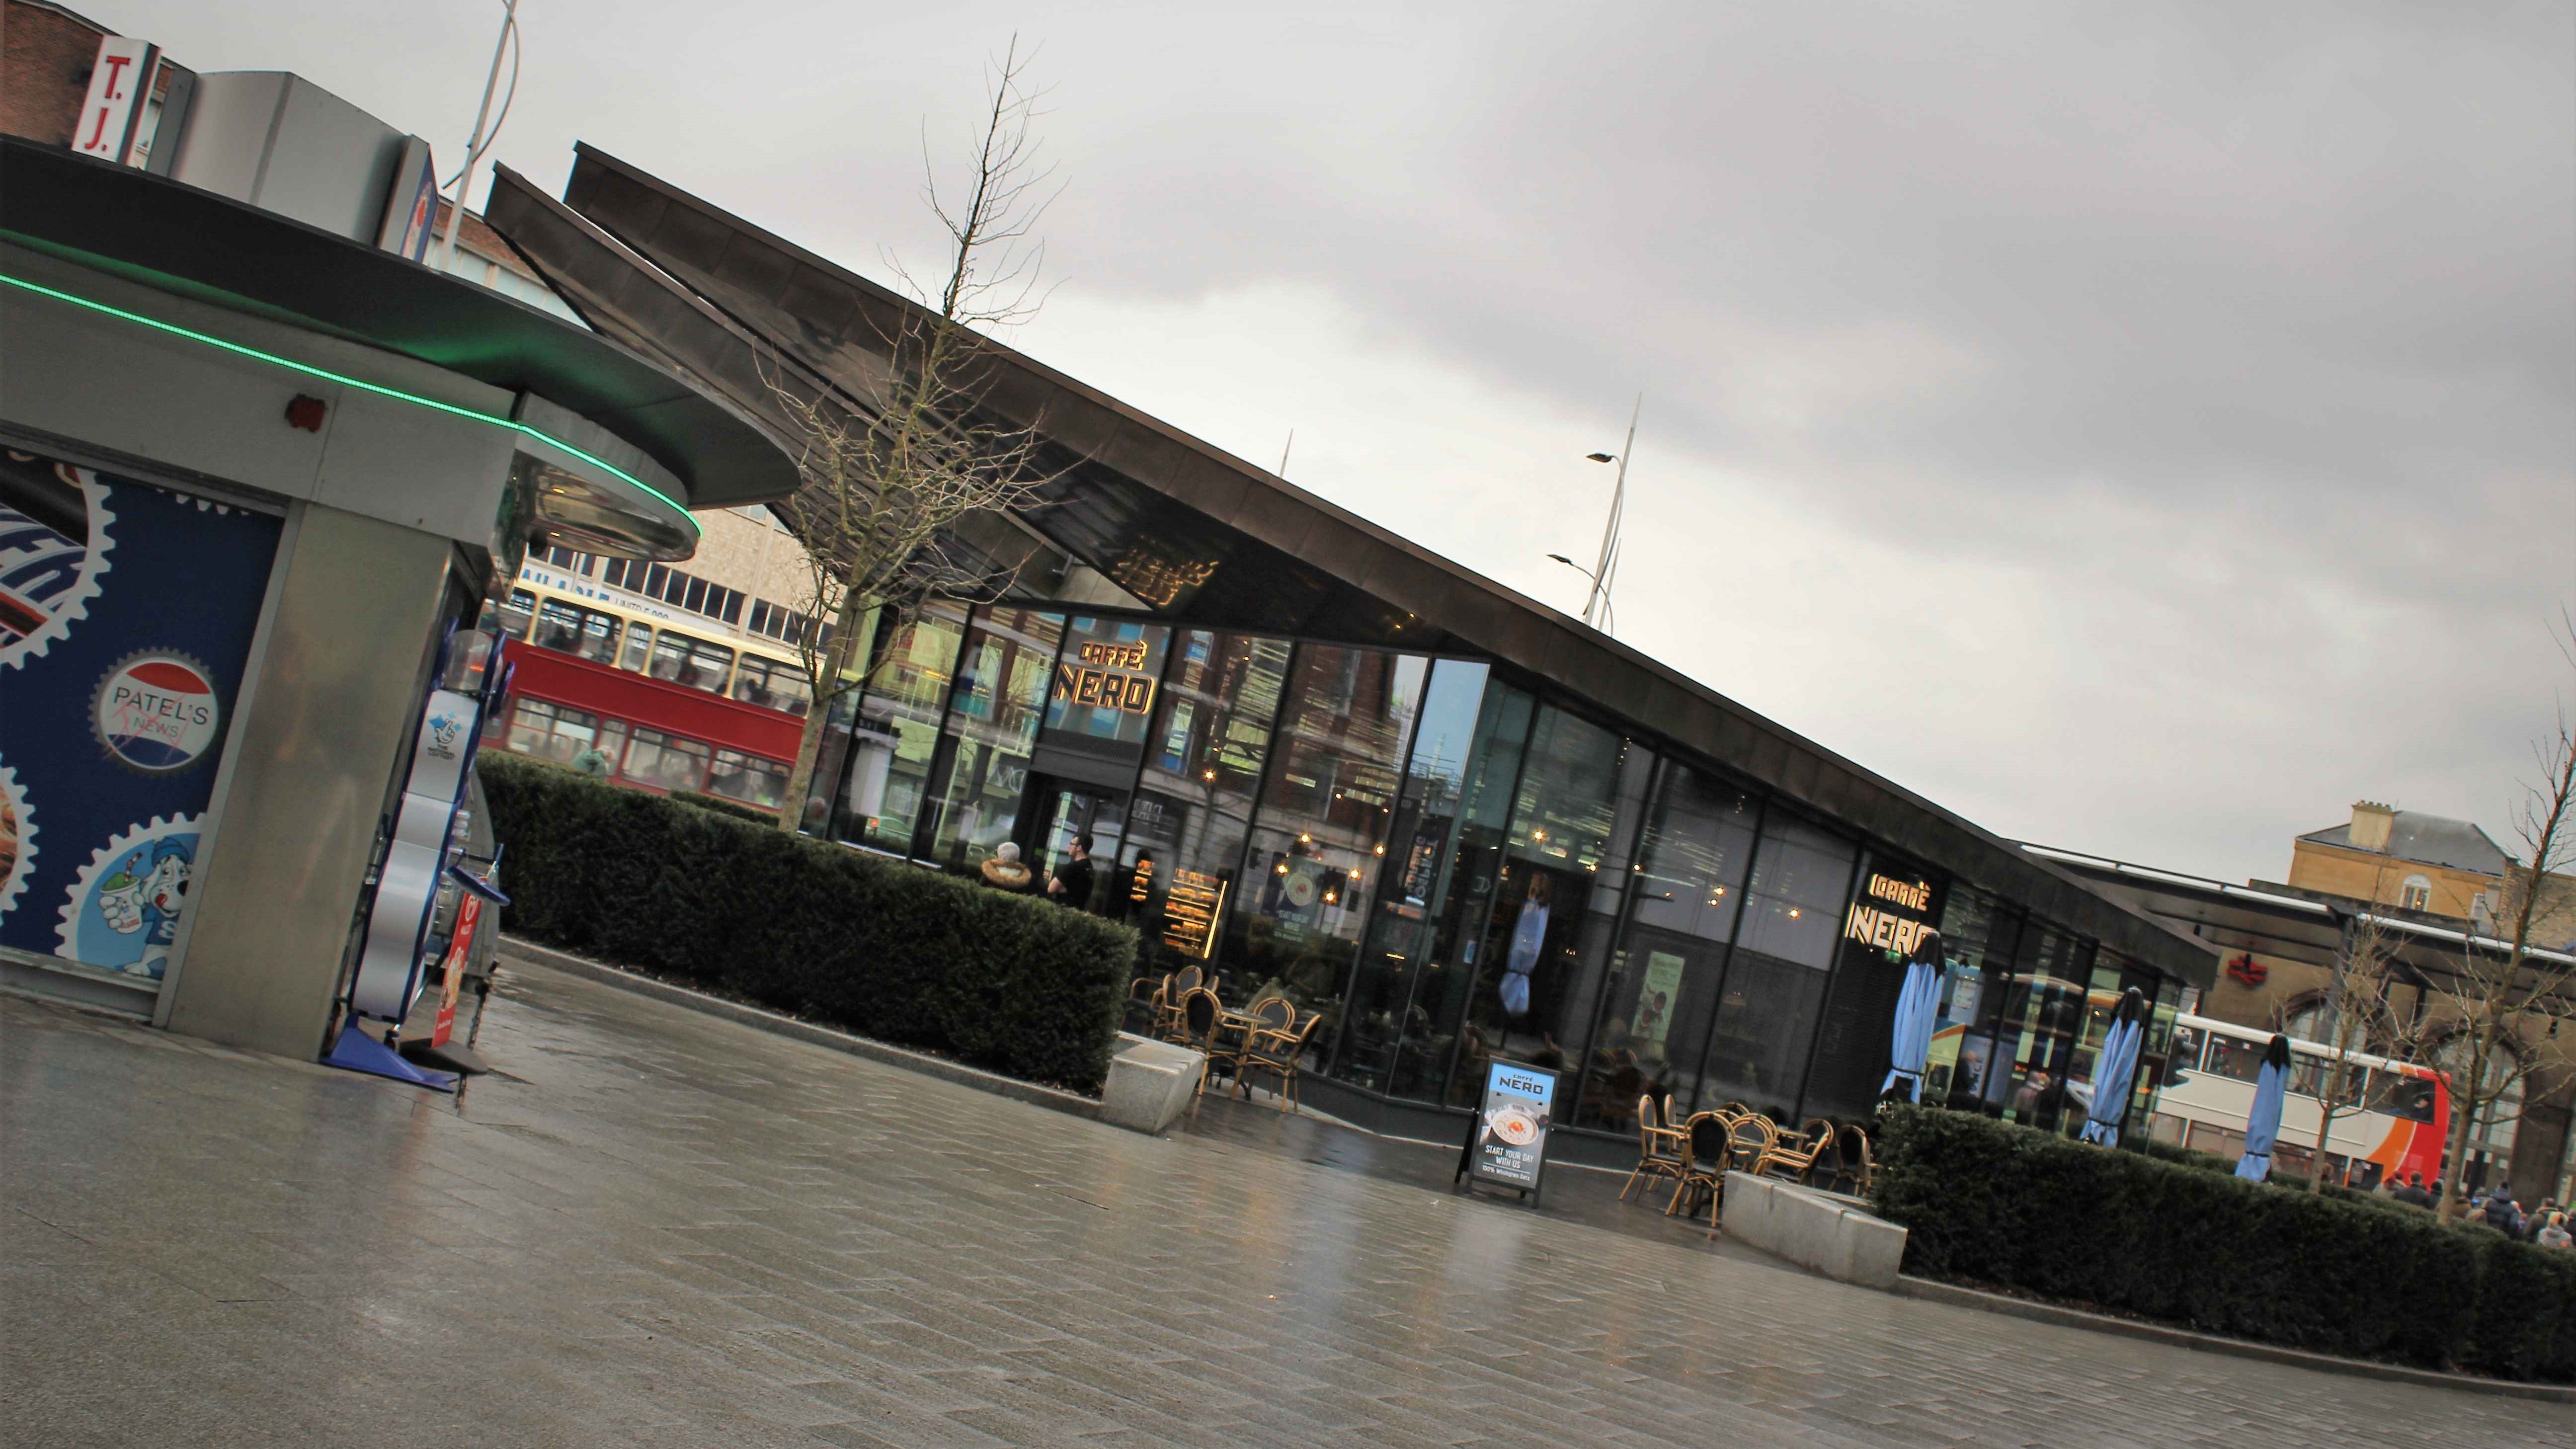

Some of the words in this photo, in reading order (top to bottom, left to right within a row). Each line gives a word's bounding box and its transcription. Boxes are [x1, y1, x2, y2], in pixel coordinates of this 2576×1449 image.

[1053, 664, 1155, 714] NERO
[114, 687, 208, 725] PATEL'S
[133, 717, 179, 738] NEWS
[1500, 1076, 1543, 1095] NERO
[1485, 1144, 1504, 1156] START
[1506, 1149, 1521, 1160] YOUR
[1523, 1153, 1534, 1163] DAY
[1496, 1156, 1511, 1167] WITH
[1512, 1160, 1521, 1169] US
